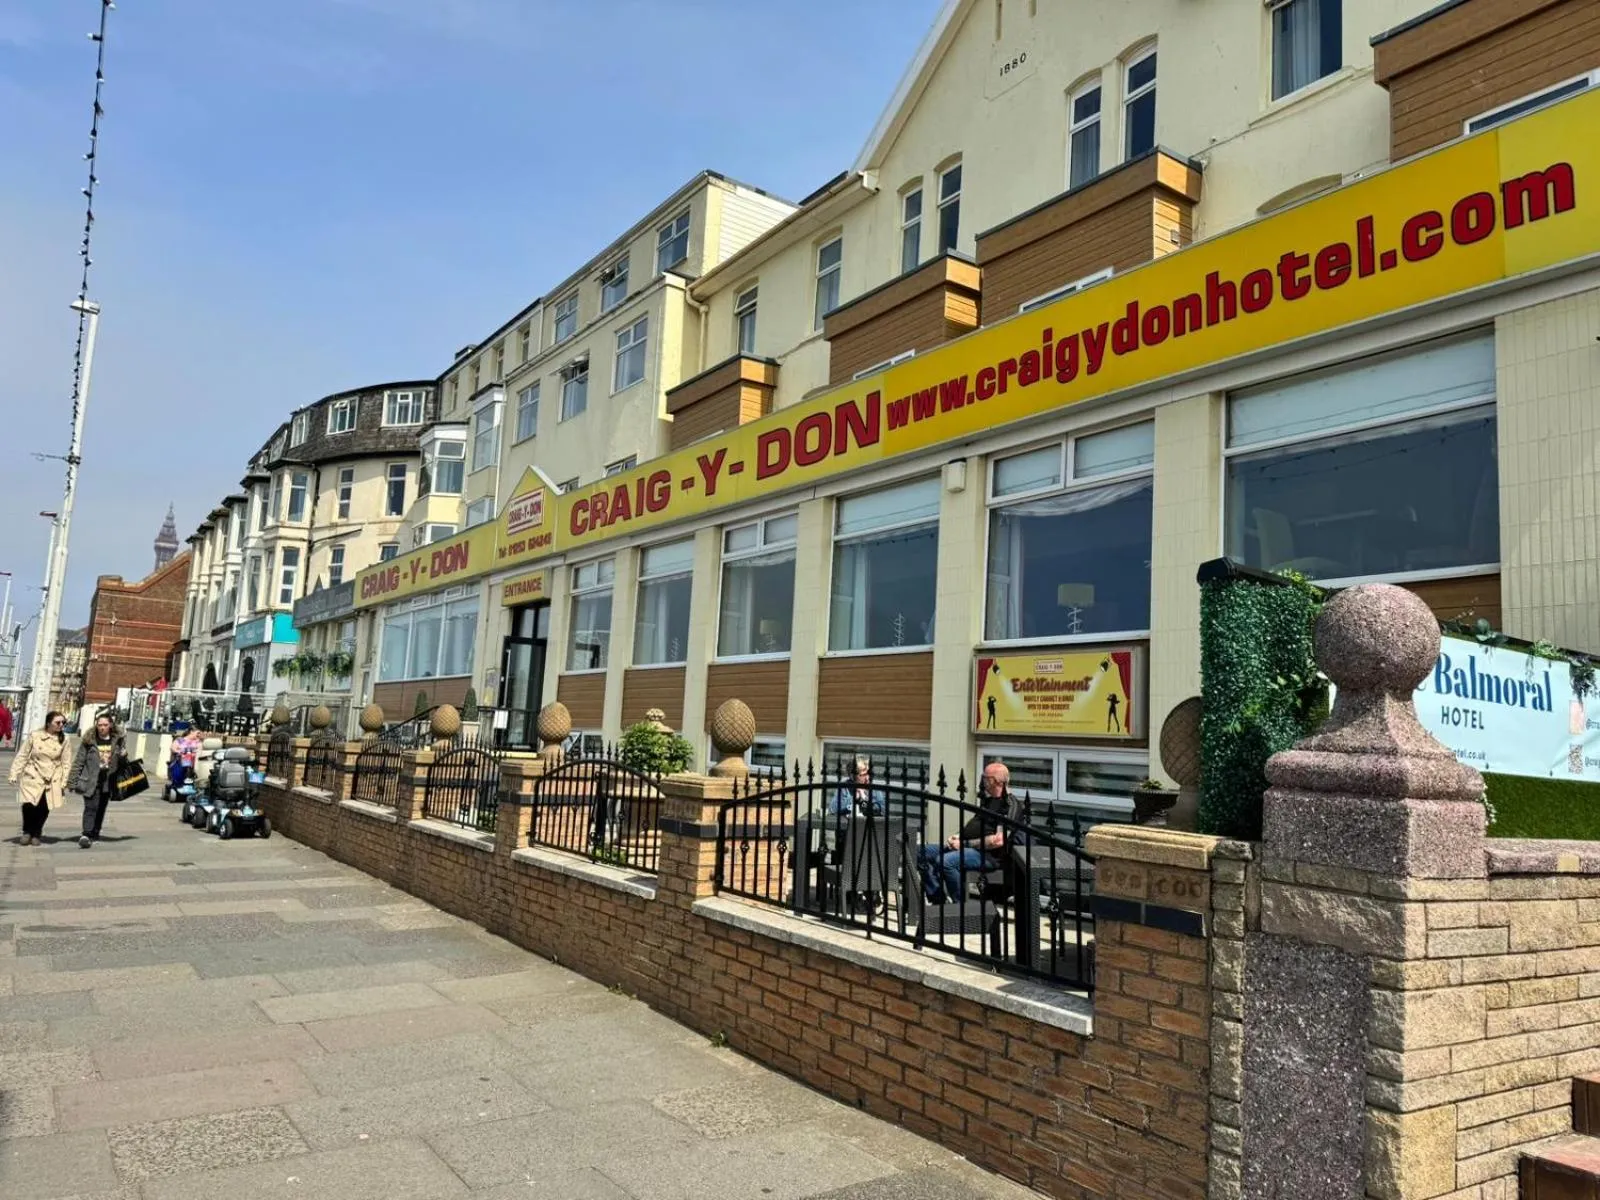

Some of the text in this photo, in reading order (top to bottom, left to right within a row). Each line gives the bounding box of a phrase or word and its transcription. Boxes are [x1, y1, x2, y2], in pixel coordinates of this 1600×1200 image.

[570, 470, 671, 536] CRAIG
[756, 390, 881, 480] DON
[887, 162, 1576, 432] www.craigydonhotel.com
[361, 566, 400, 599] CRAIG
[430, 541, 469, 579] DON
[504, 577, 542, 597] ENTRANCE
[1010, 676, 1093, 693] Entertainment
[1434, 653, 1553, 712] Balmoral
[1441, 705, 1485, 730] HOTEL
